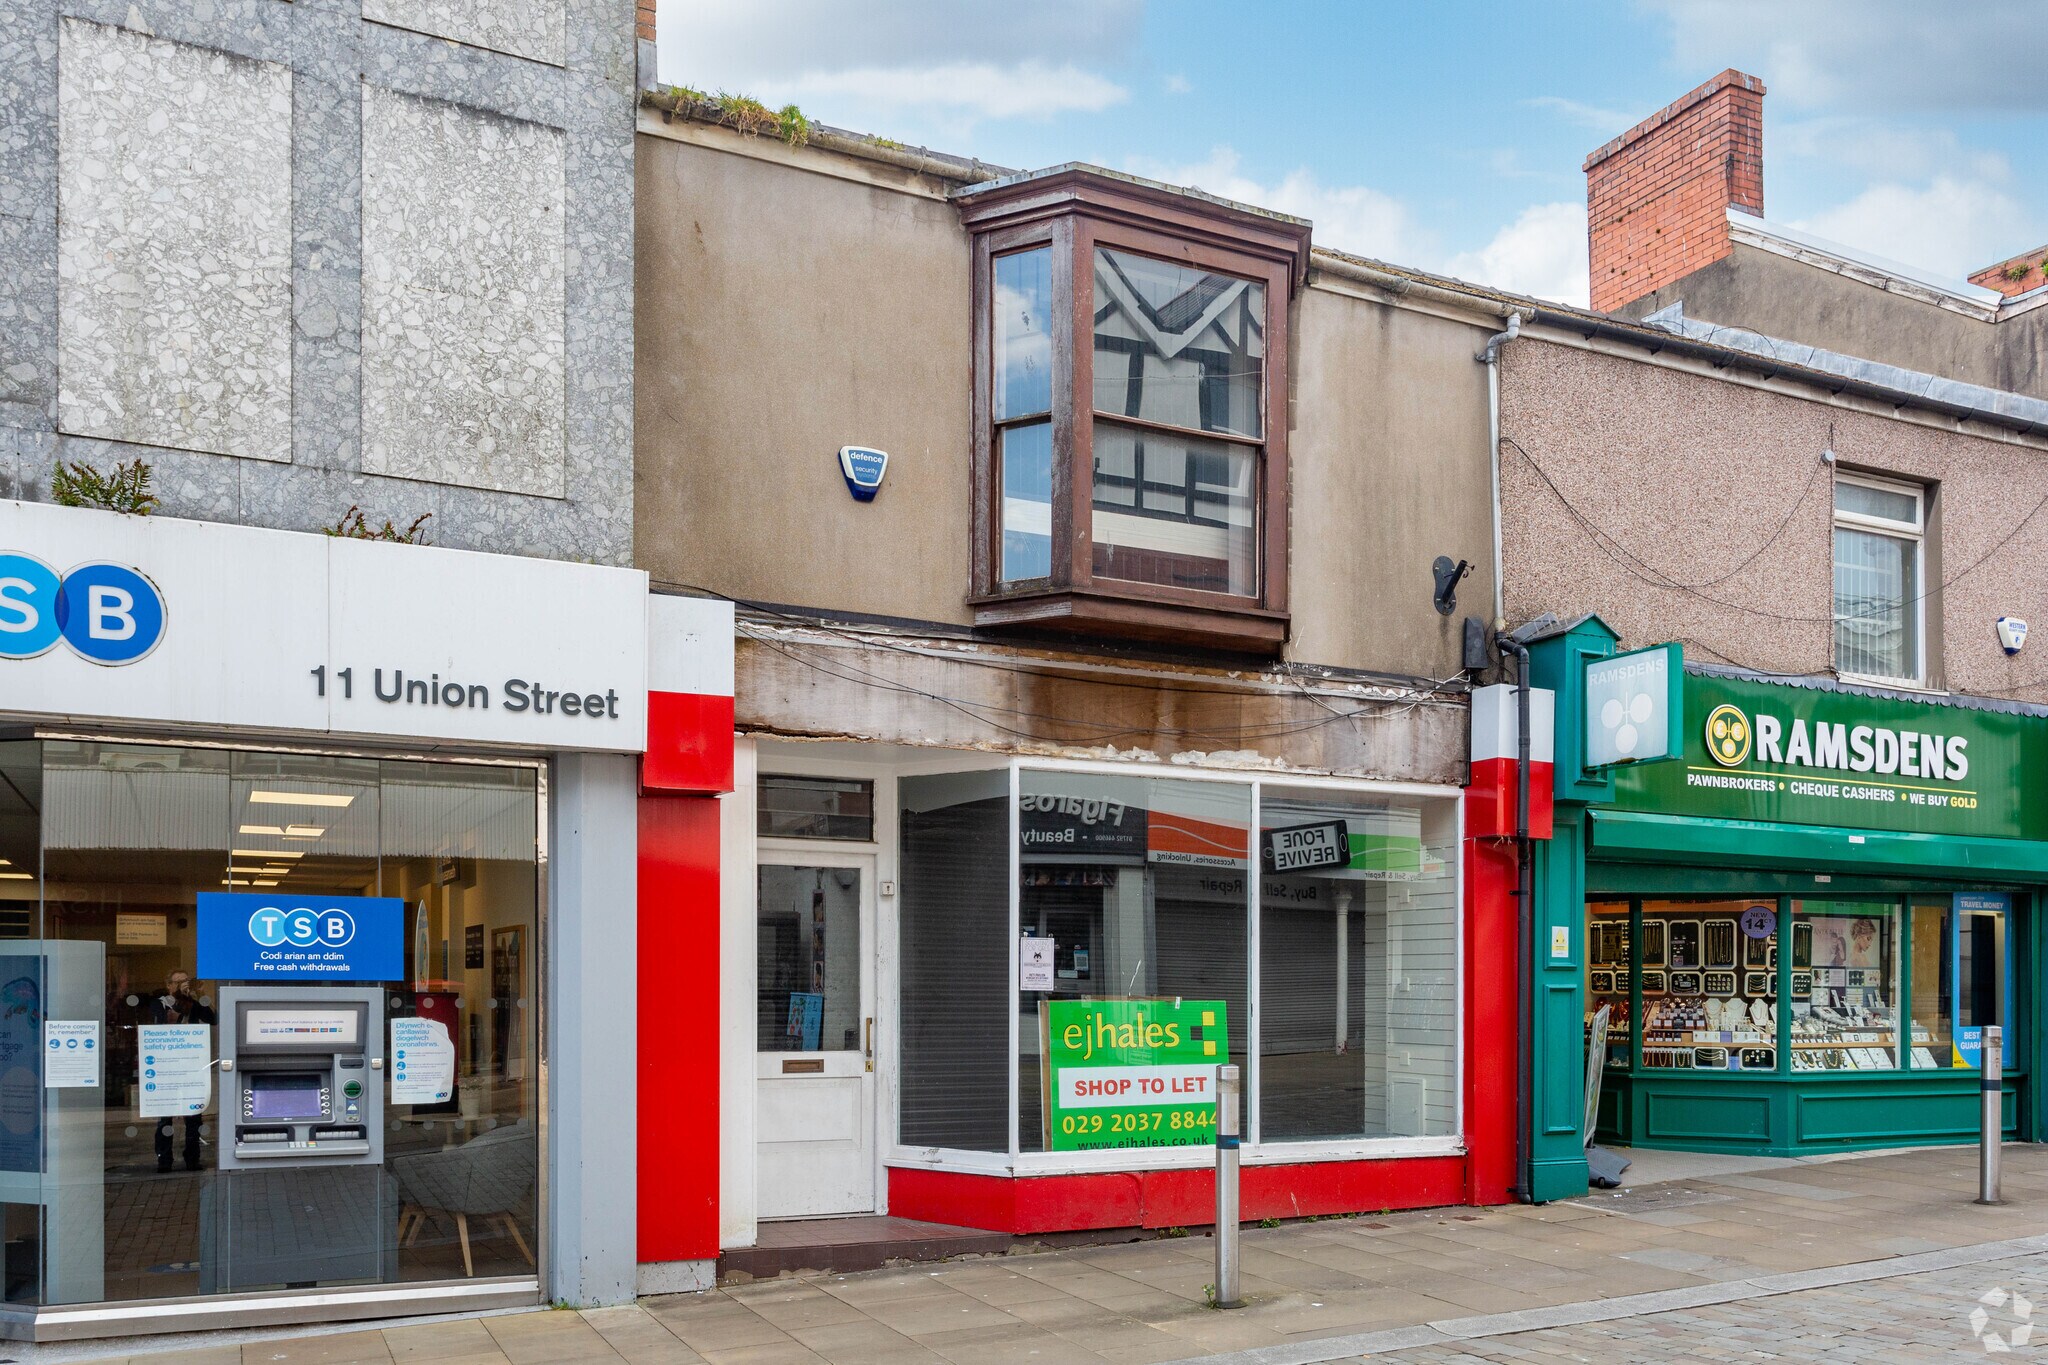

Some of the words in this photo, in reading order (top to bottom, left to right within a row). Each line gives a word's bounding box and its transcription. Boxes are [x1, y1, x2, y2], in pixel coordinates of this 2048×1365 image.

[850, 452, 883, 464] defence
[1588, 658, 1665, 687] RAMSDENS
[310, 664, 352, 699] 11
[374, 668, 488, 709] Union
[503, 678, 619, 719] Street
[1755, 714, 1969, 781] RAMSDENS
[1687, 773, 1776, 792] PAWNBROKERS
[1790, 781, 1839, 798] CHEQUE
[1842, 786, 1895, 802] CASHERS
[1909, 792, 1926, 805] WE
[1928, 794, 1949, 807] BUY
[1950, 796, 1977, 809] GOLD
[1960, 900, 1983, 908] TRAVEL
[1983, 901, 2004, 909] MONEY
[261, 916, 345, 939] TSB
[260, 951, 282, 960] Codi
[284, 951, 305, 960] arian
[323, 952, 344, 960] ddim
[254, 963, 275, 971] Free
[276, 963, 298, 971] cash
[299, 963, 350, 972] withdrawals
[395, 1022, 426, 1030] Dilynwch
[1963, 1031, 1981, 1040] BEST
[1063, 1012, 1180, 1061] ejhales
[143, 1043, 167, 1051] safety
[167, 1043, 205, 1051] guidelines.
[1074, 1079, 1131, 1097] SHOP
[1138, 1078, 1165, 1095] TO
[1171, 1077, 1208, 1094] LET
[1062, 1114, 1103, 1135] 029
[1110, 1112, 1163, 1133] 2037
